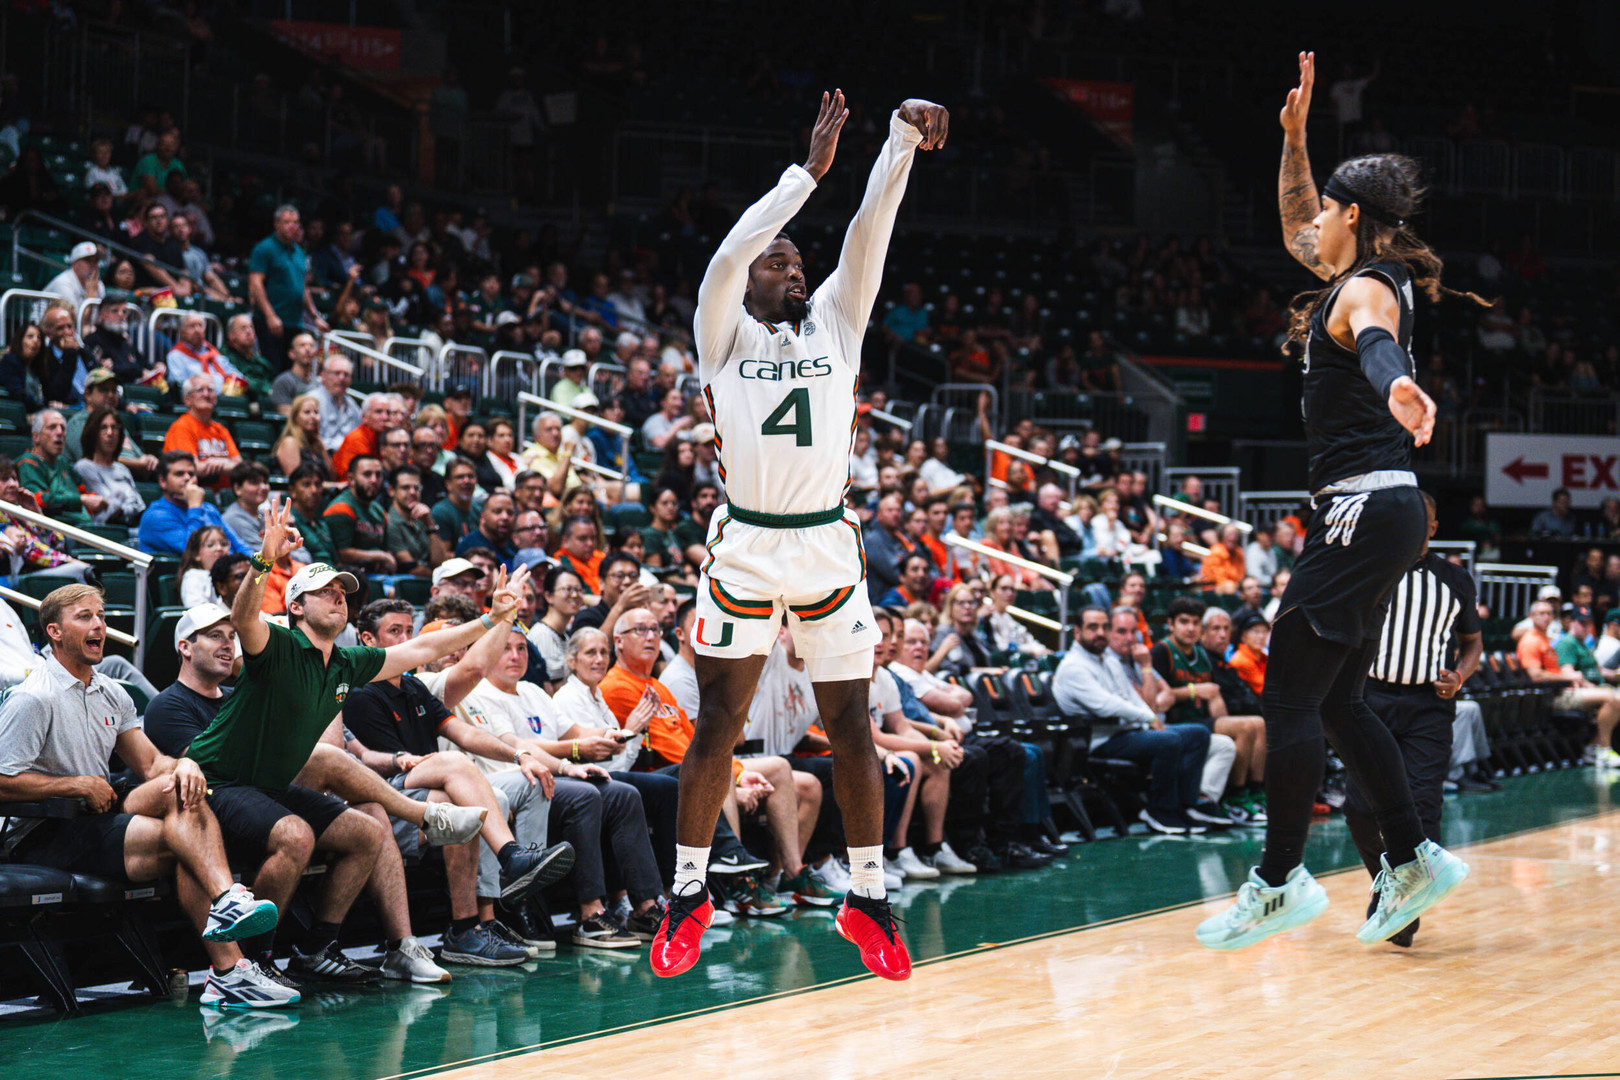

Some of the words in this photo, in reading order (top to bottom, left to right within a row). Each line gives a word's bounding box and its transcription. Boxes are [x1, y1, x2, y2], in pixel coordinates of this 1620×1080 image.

[739, 356, 832, 381] canes
[762, 387, 812, 446] 4
[697, 617, 734, 648] U
[104, 716, 116, 727] U
[415, 704, 427, 717] U
